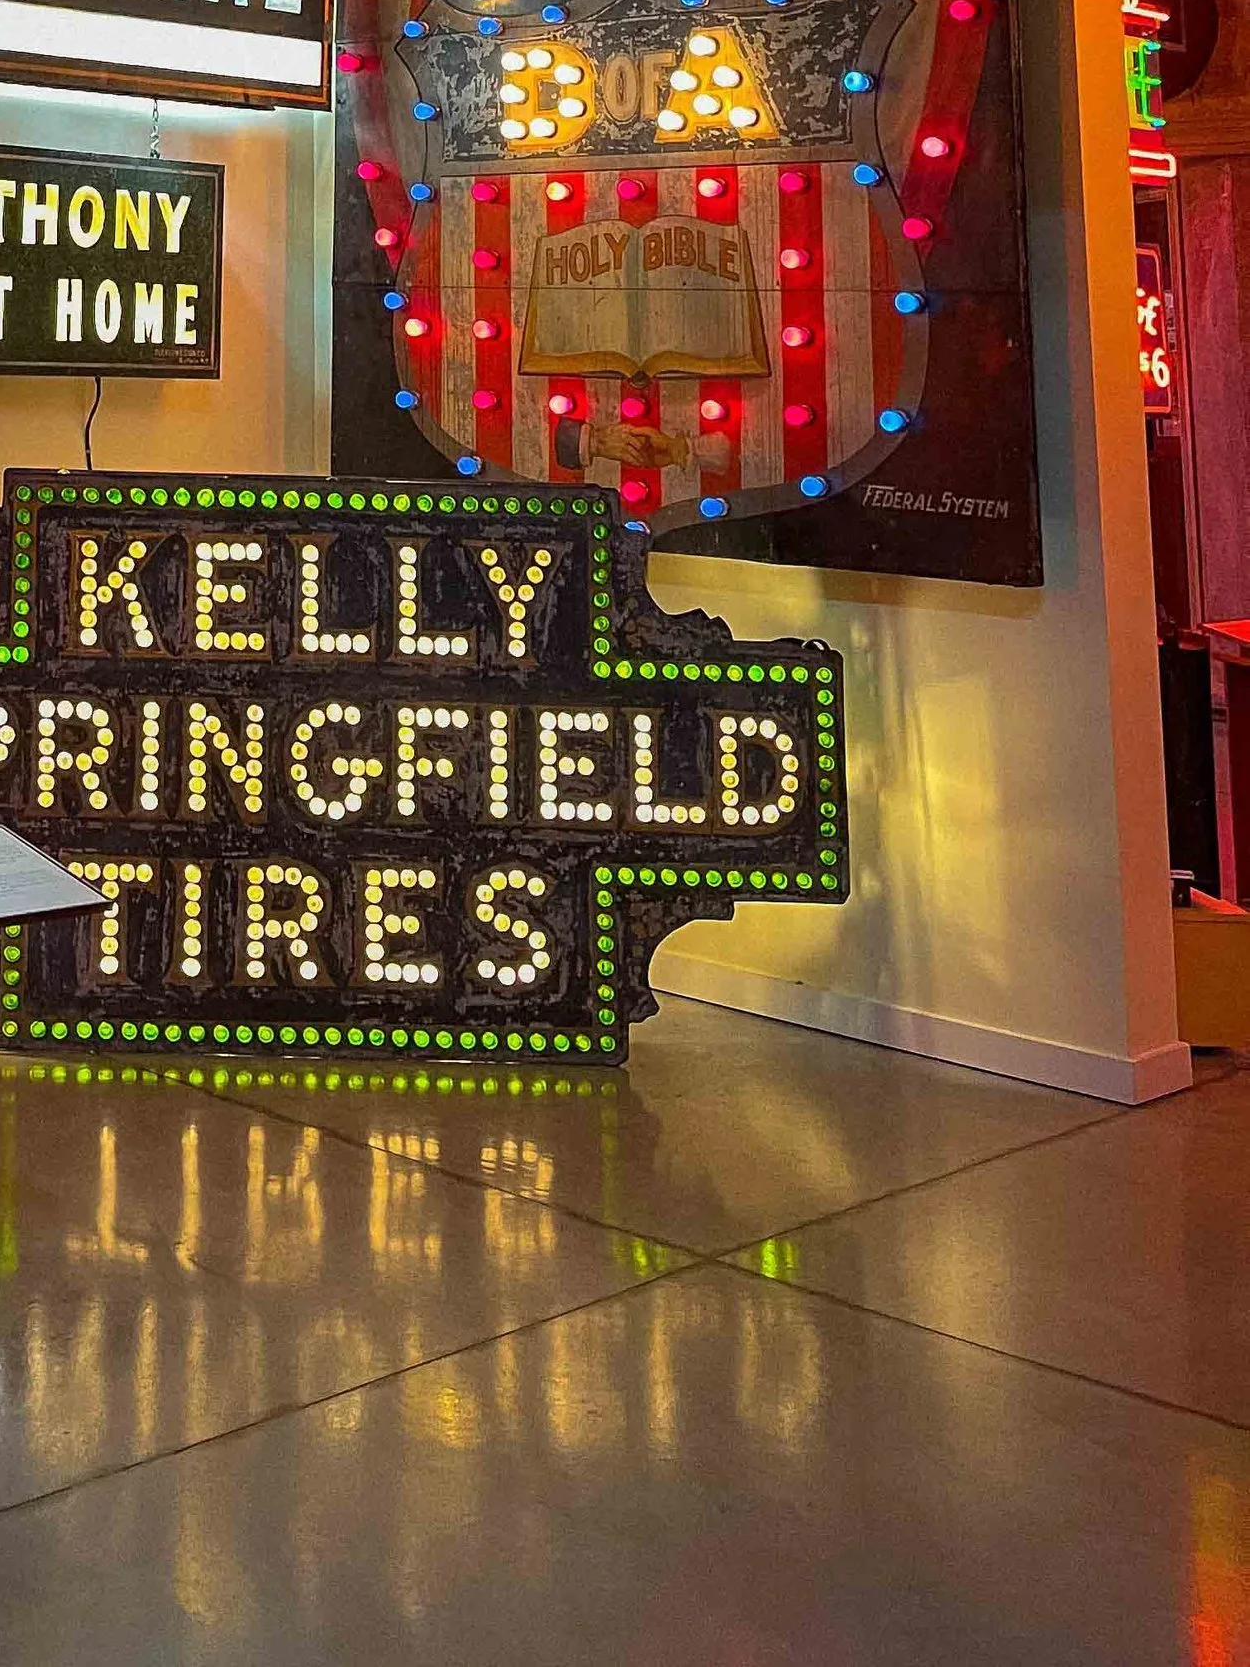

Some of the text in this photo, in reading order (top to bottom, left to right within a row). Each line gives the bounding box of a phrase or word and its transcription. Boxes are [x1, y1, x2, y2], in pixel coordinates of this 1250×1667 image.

[545, 226, 740, 286] HOLY BIBLE
[55, 278, 199, 345] HOME
[862, 484, 1010, 519] FEDERAL SYSTEM
[80, 539, 552, 658] KELLY
[68, 860, 551, 987] TIRES
